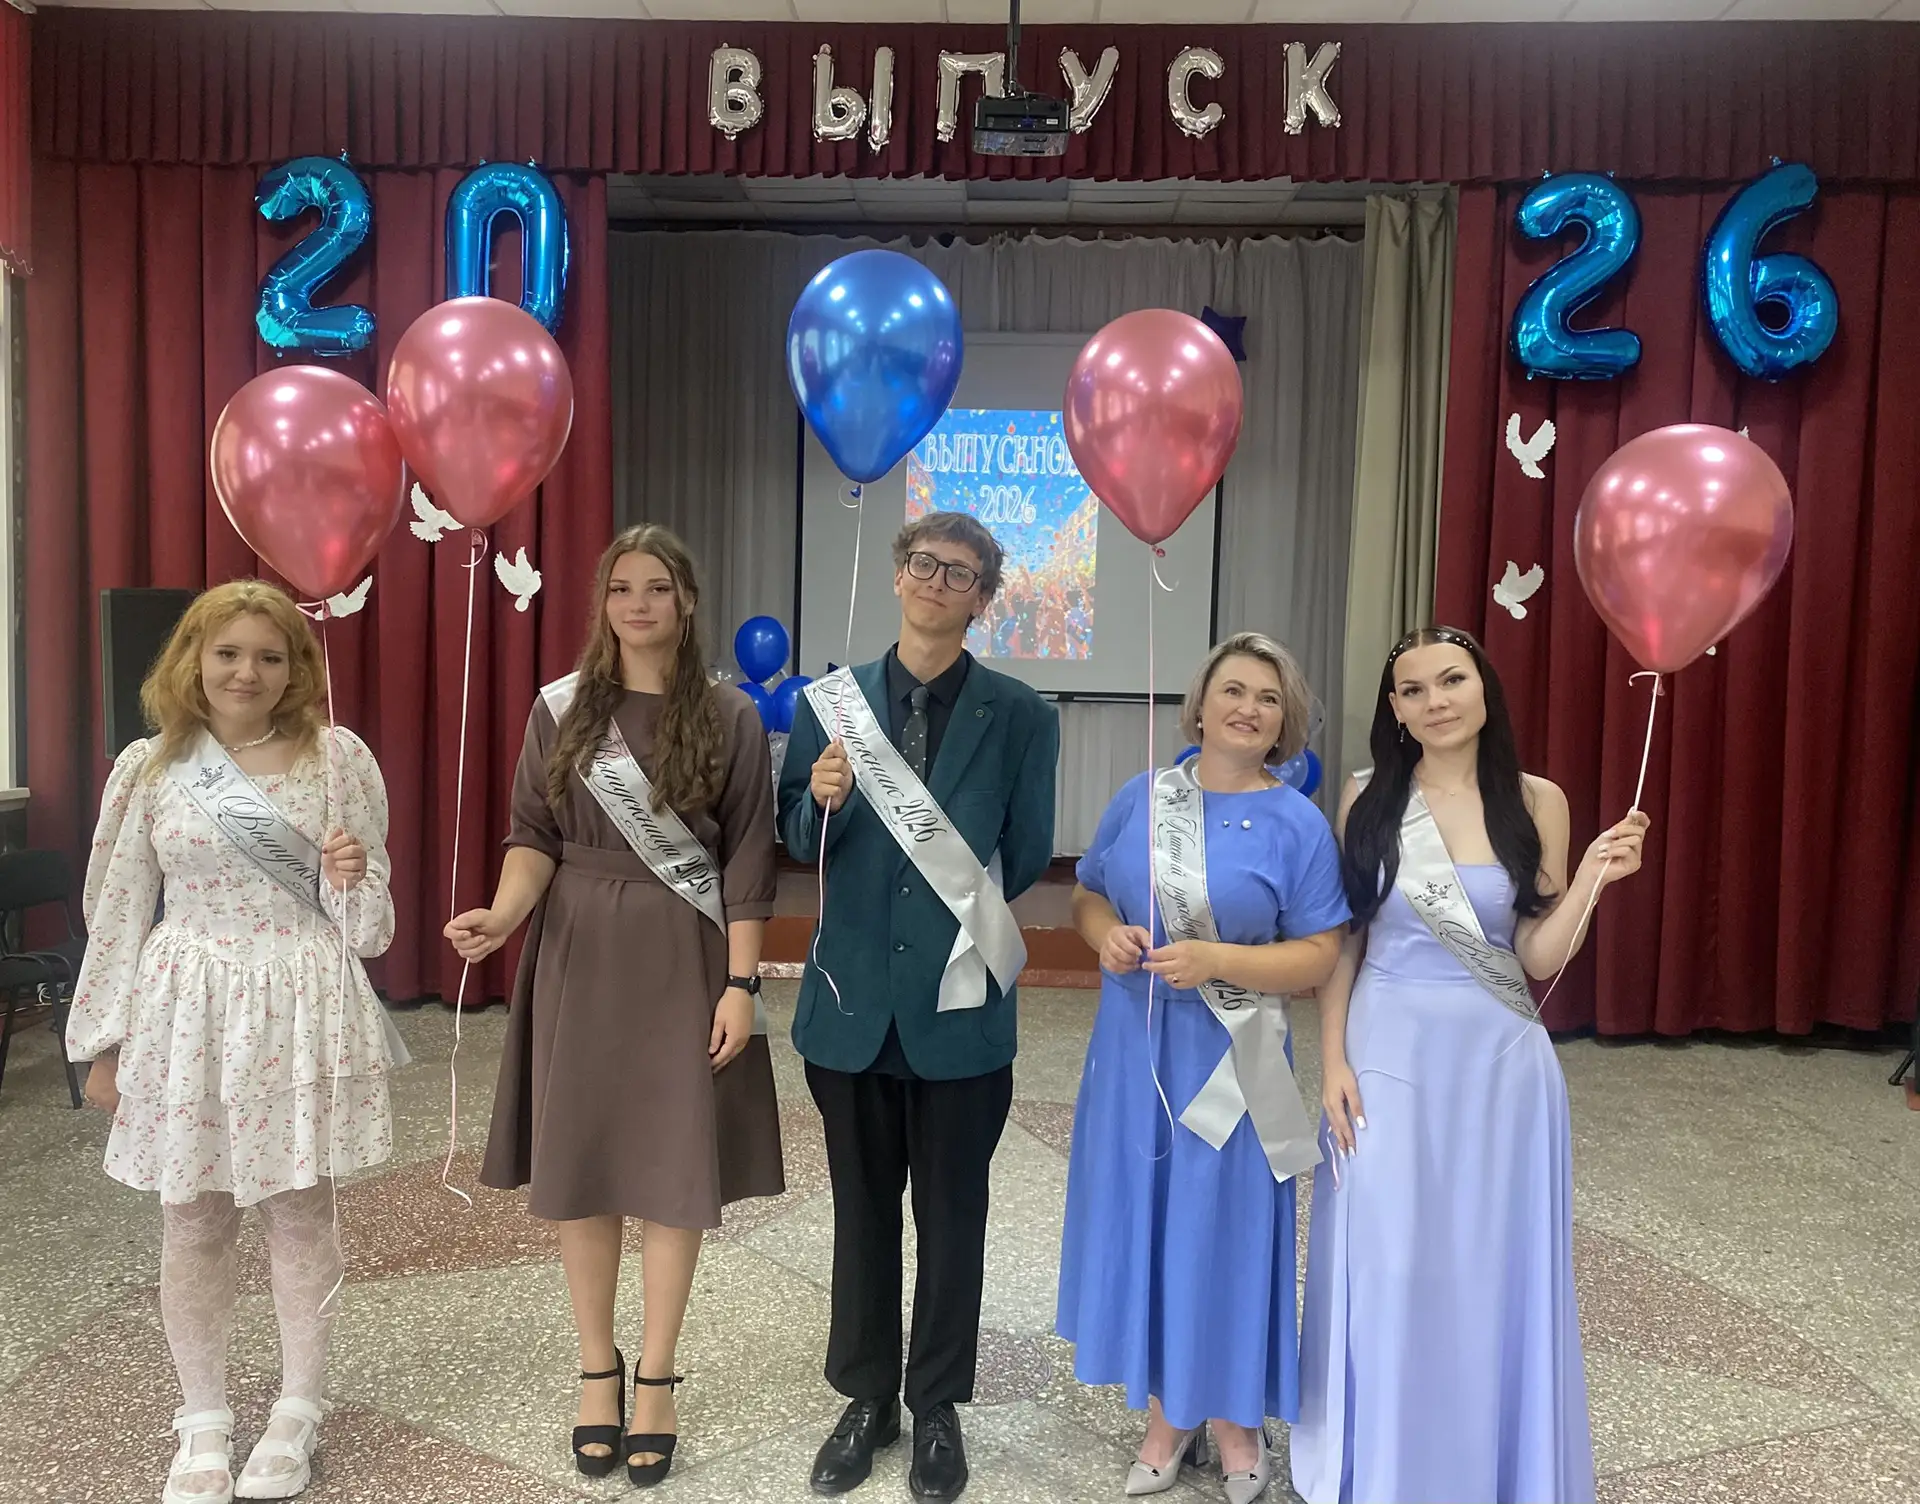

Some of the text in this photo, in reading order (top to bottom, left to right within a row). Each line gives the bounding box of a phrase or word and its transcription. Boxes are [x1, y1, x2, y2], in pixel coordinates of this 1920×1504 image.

[708, 41, 1341, 154] ВЫПУСК
[978, 484, 1036, 523] 2026
[817, 674, 947, 843] Выпускник 2026
[218, 795, 319, 888] Выпускн
[592, 735, 719, 895] Выпускница 2026
[1211, 978, 1255, 1010] 026
